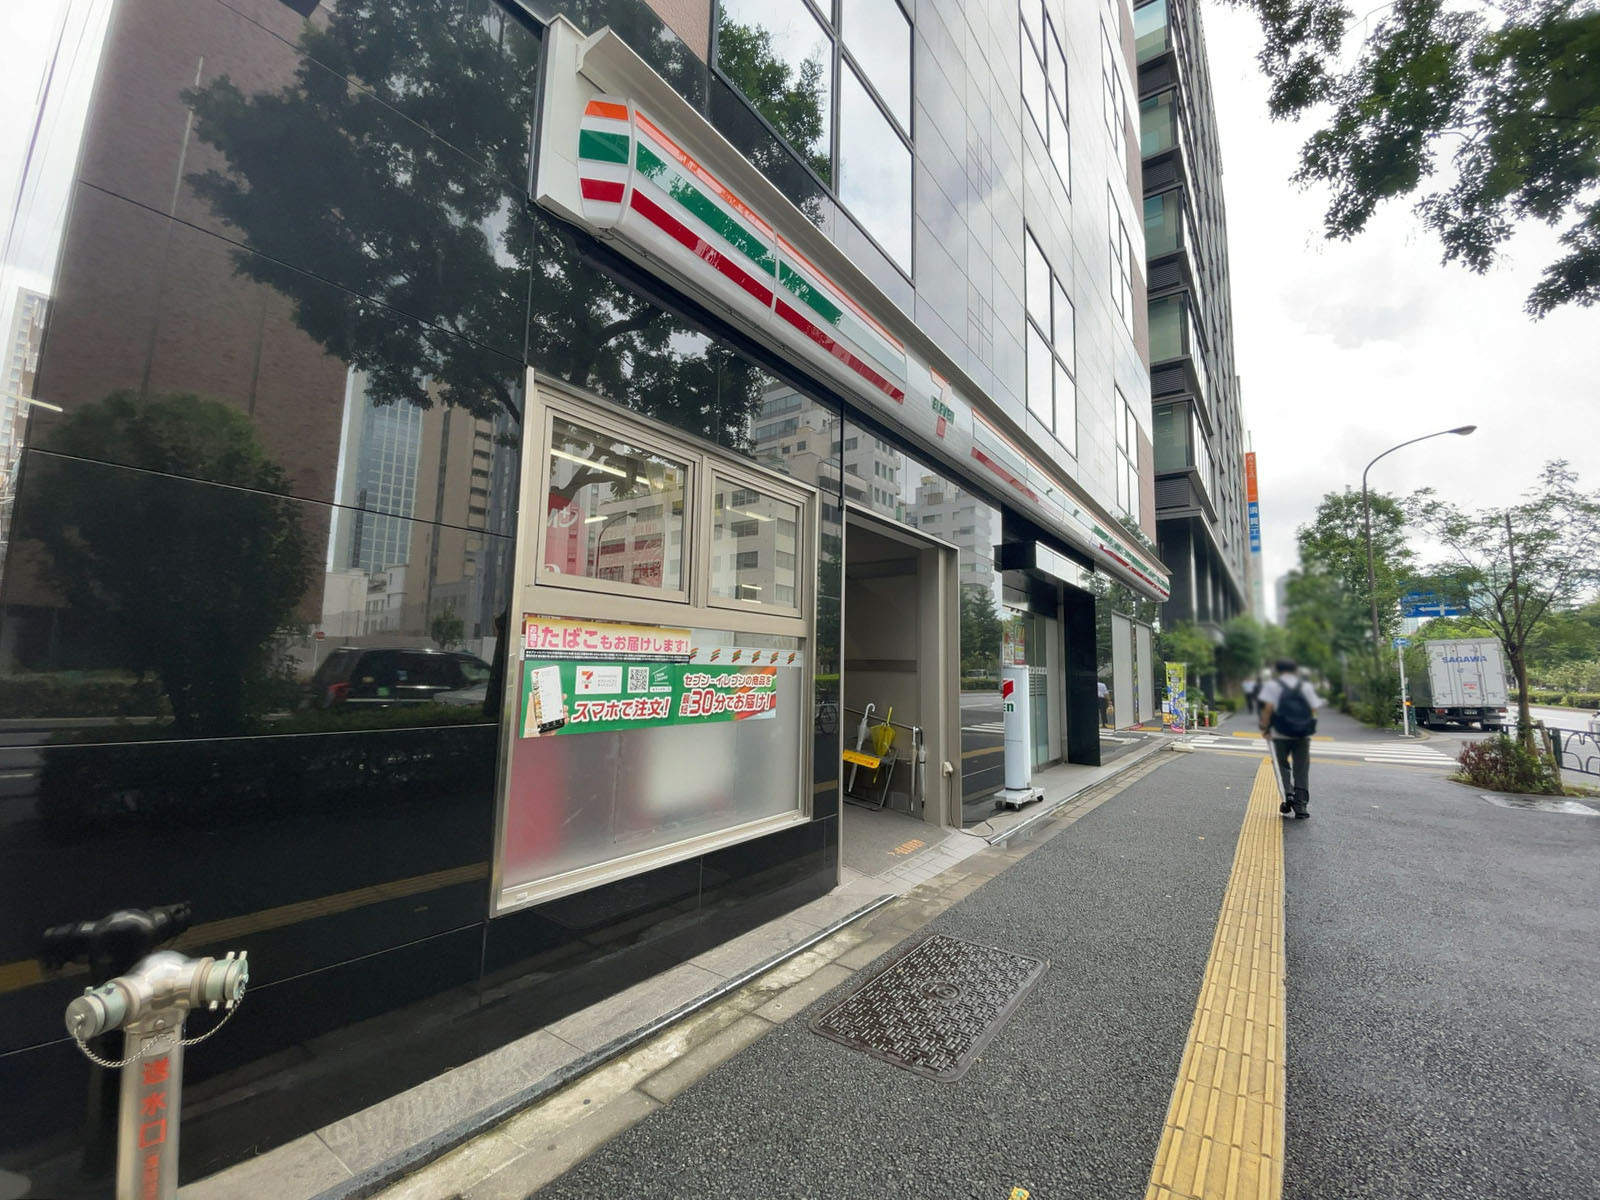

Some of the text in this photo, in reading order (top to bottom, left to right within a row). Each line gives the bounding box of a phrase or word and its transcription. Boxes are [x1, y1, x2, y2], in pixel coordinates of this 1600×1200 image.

[541, 626, 689, 653] たばこもお届けします!
[1441, 655, 1488, 664] SAGAWA
[572, 698, 671, 720] スマホで注文!
